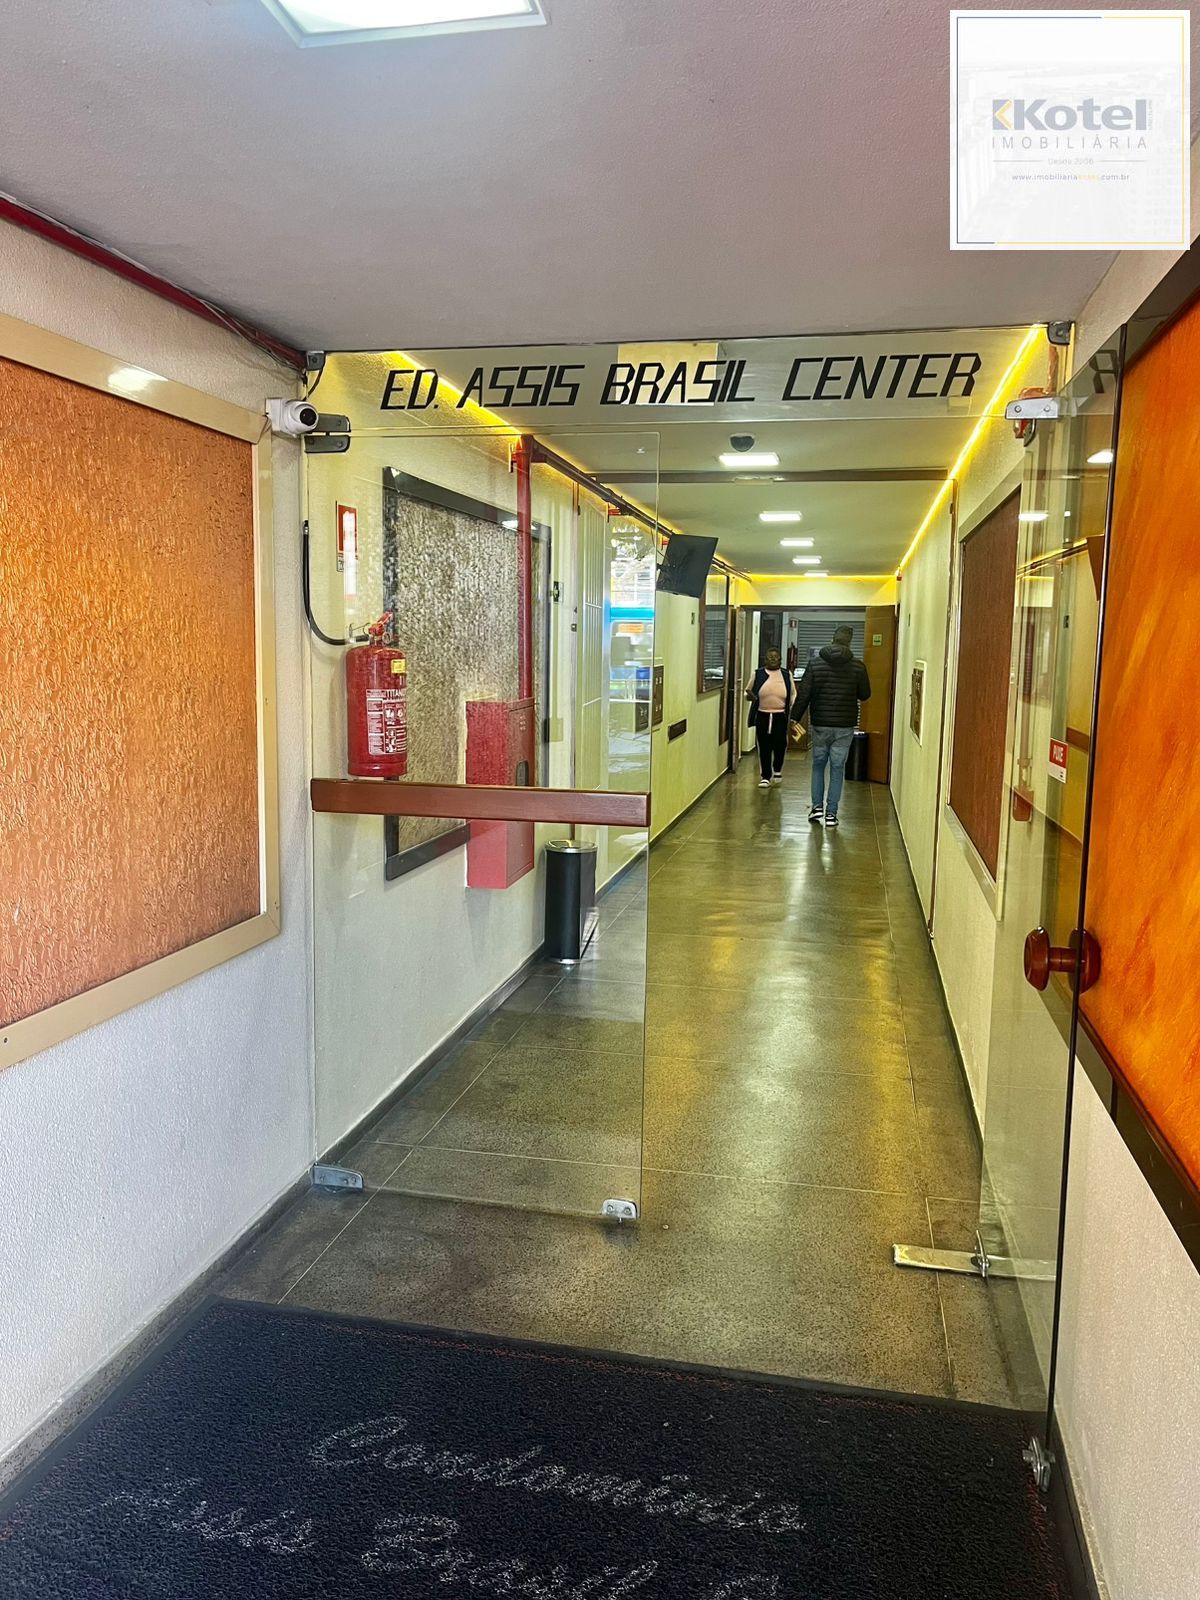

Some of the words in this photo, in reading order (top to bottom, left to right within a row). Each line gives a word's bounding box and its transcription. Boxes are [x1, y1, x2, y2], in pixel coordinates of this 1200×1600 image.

[380, 368, 438, 410] ED.
[456, 364, 585, 409] ASSIS
[600, 360, 755, 406] BRASIL
[781, 353, 981, 402] CENTER
